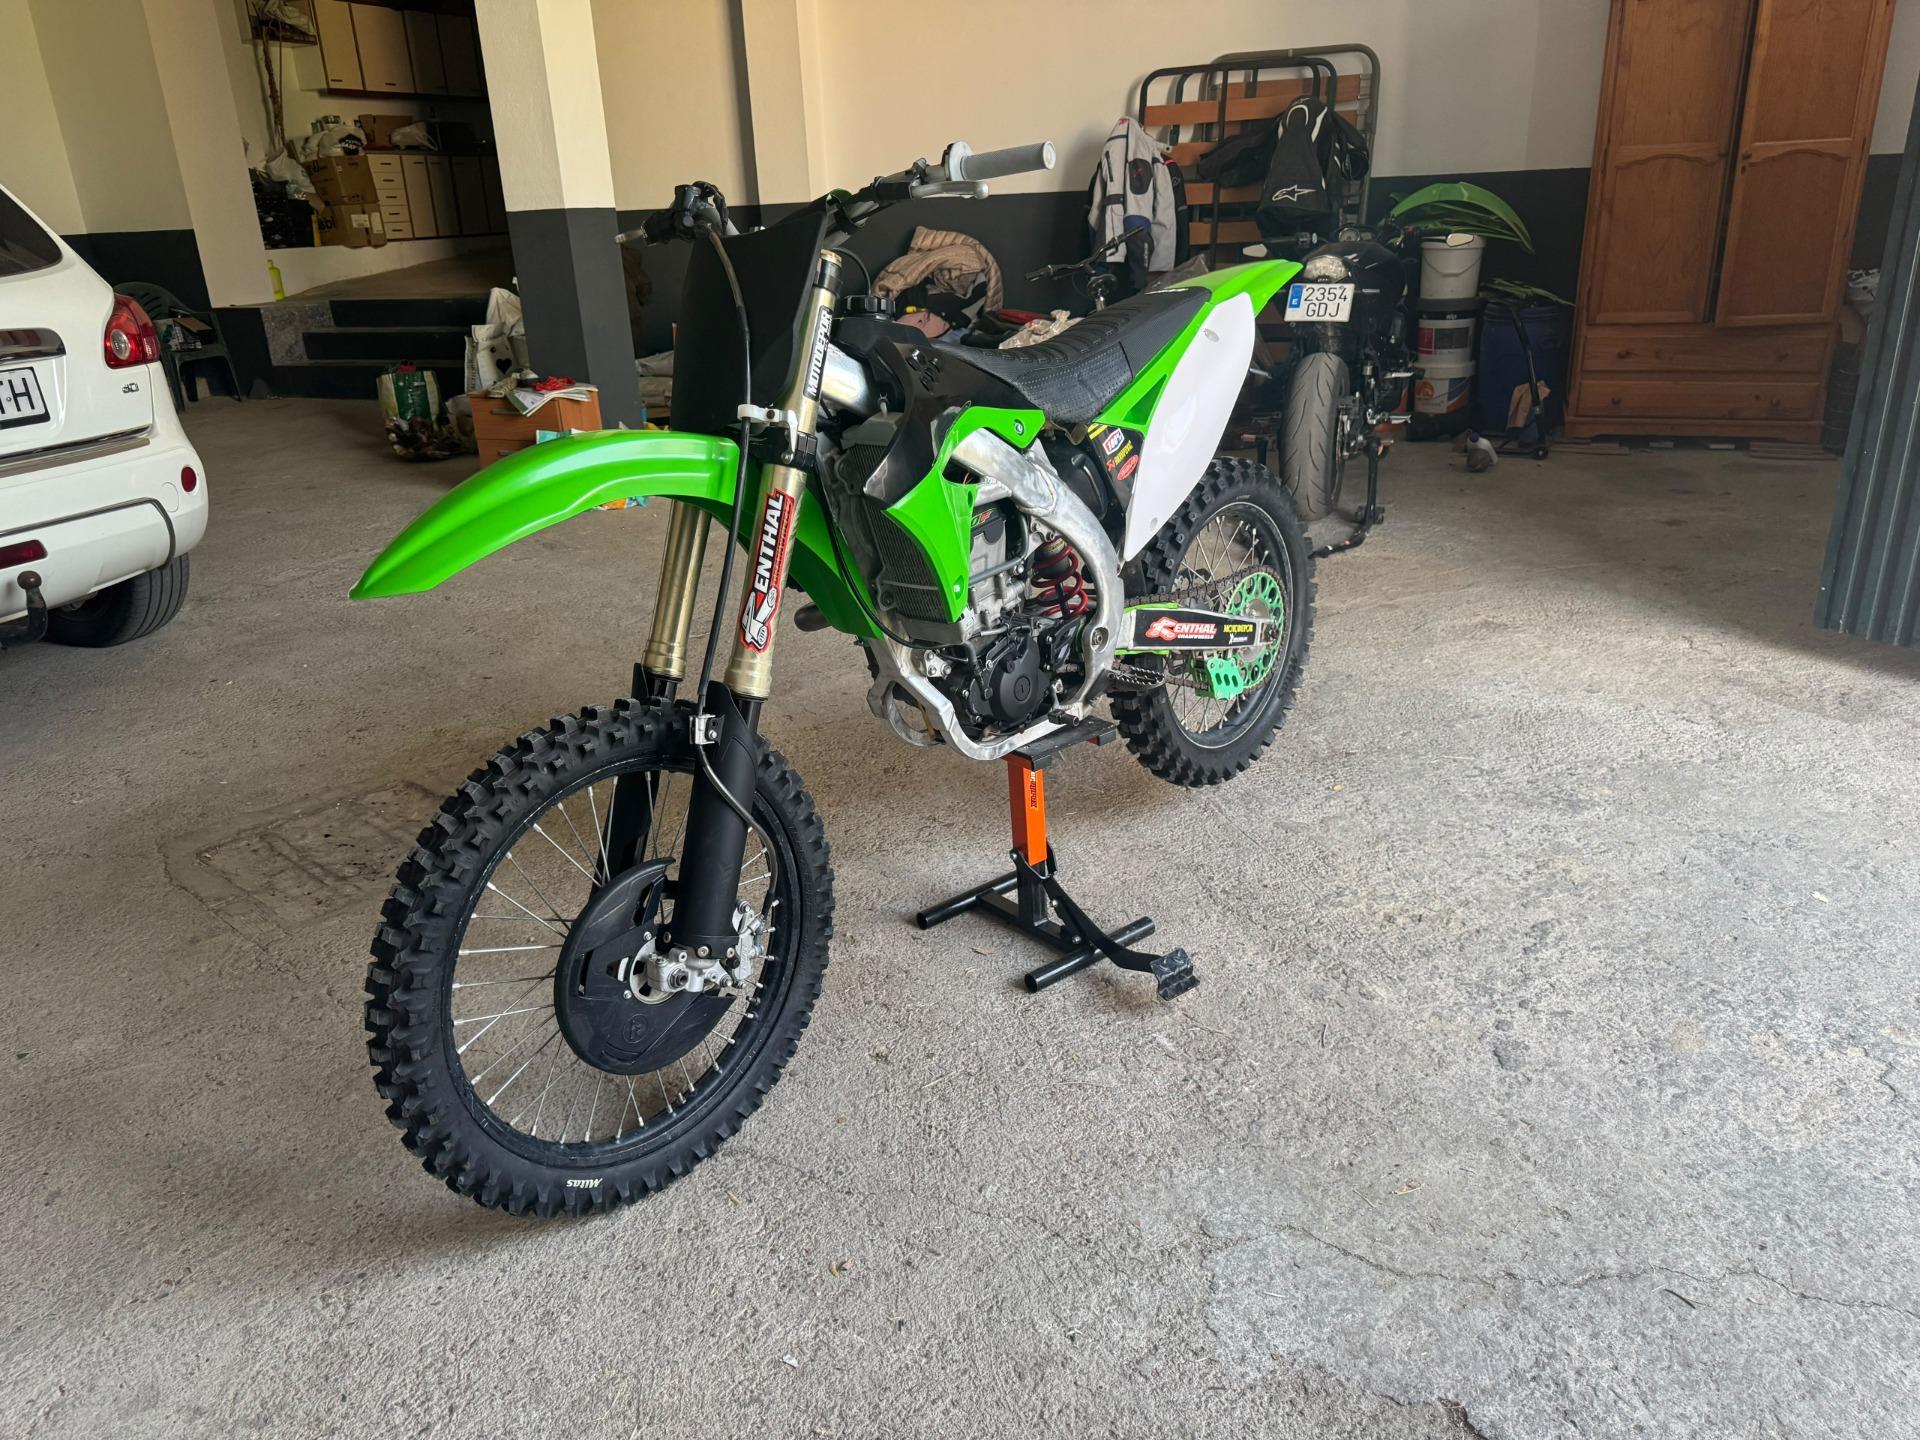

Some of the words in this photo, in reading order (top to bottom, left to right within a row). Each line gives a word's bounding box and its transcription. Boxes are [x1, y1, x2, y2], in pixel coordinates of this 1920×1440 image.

[1304, 287, 1347, 302] 2354
[1306, 302, 1340, 317] GDJ
[808, 310, 832, 396] MOTODEPOR
[742, 494, 784, 649] RENTHAL
[1146, 617, 1217, 640] RENTHAL
[566, 1178, 603, 1189] Mitas
